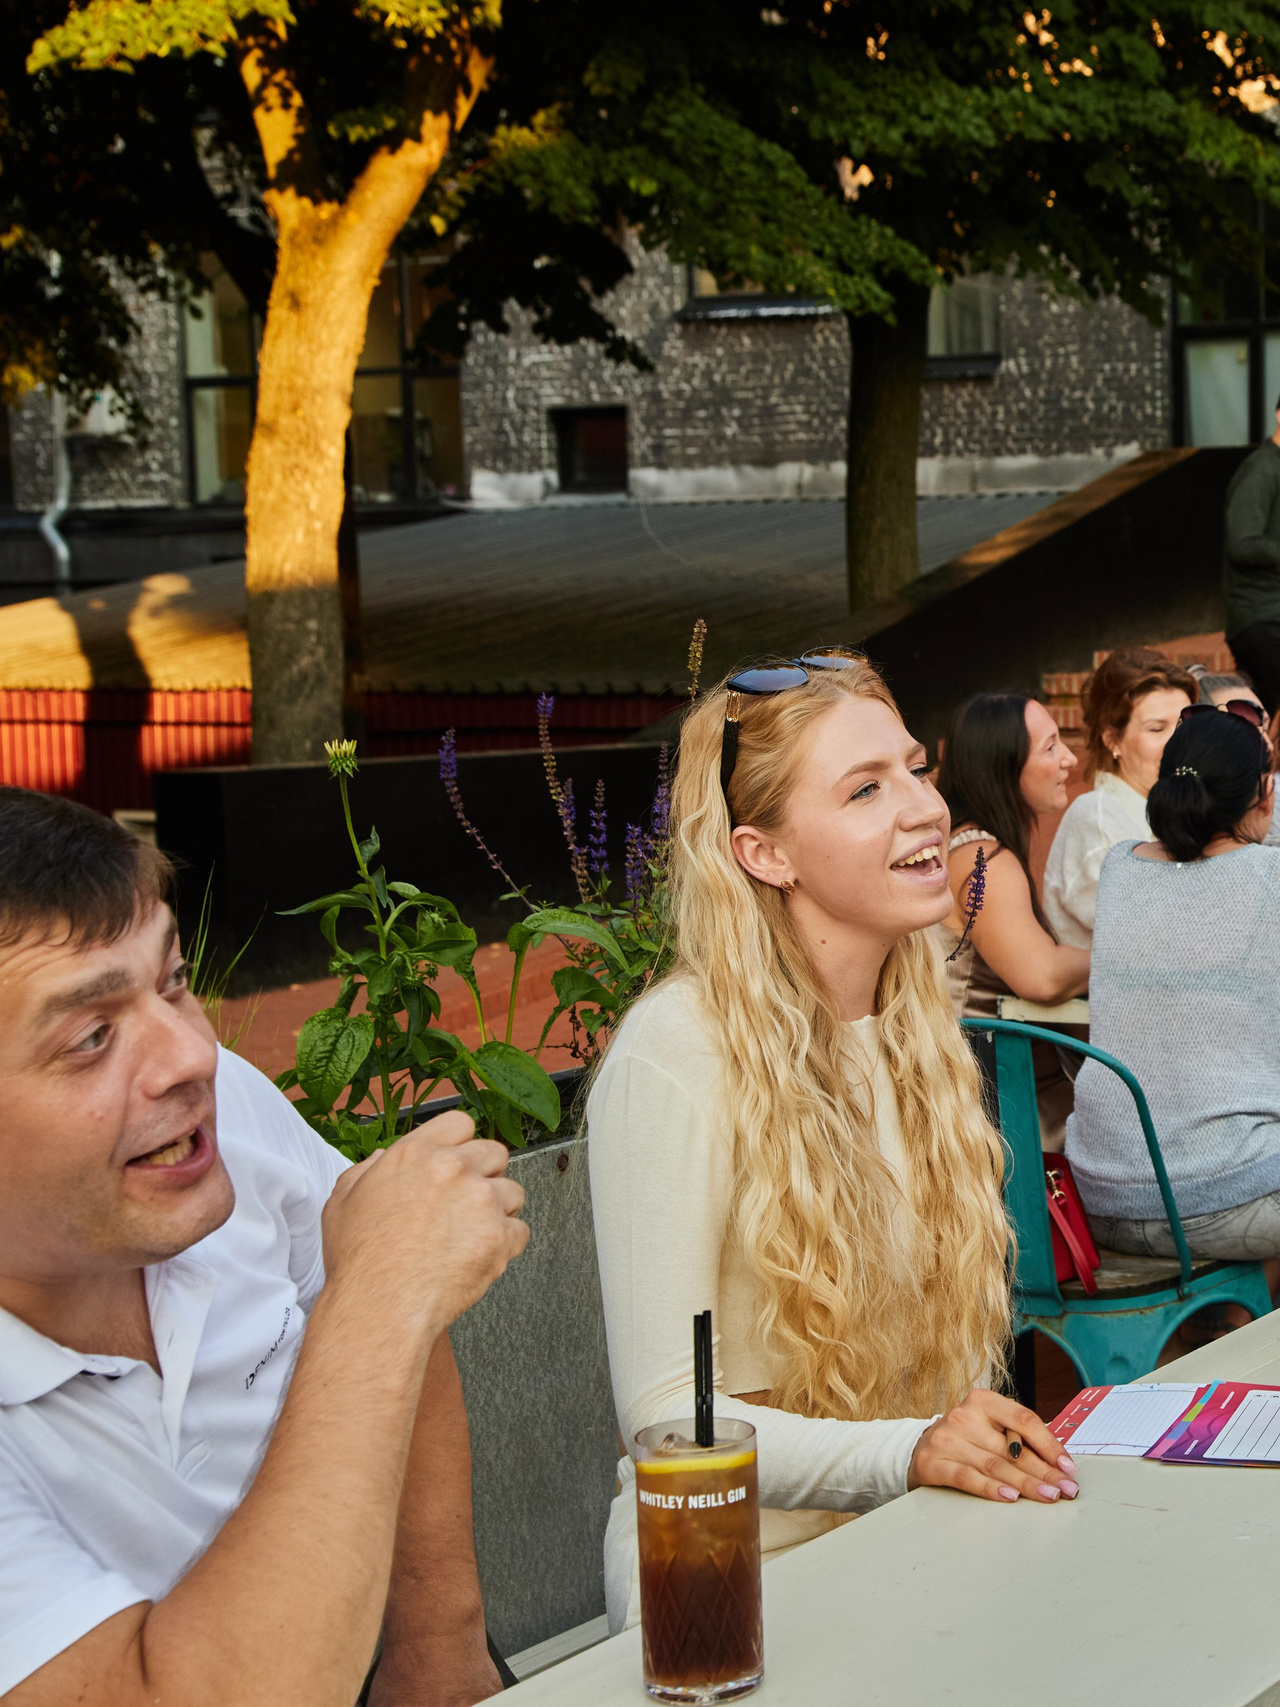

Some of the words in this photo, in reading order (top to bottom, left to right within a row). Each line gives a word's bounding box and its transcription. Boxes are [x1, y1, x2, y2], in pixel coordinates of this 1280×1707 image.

[639, 1489, 684, 1509] WHITLEY
[688, 1492, 726, 1509] NEILL
[727, 1486, 746, 1504] GIN
